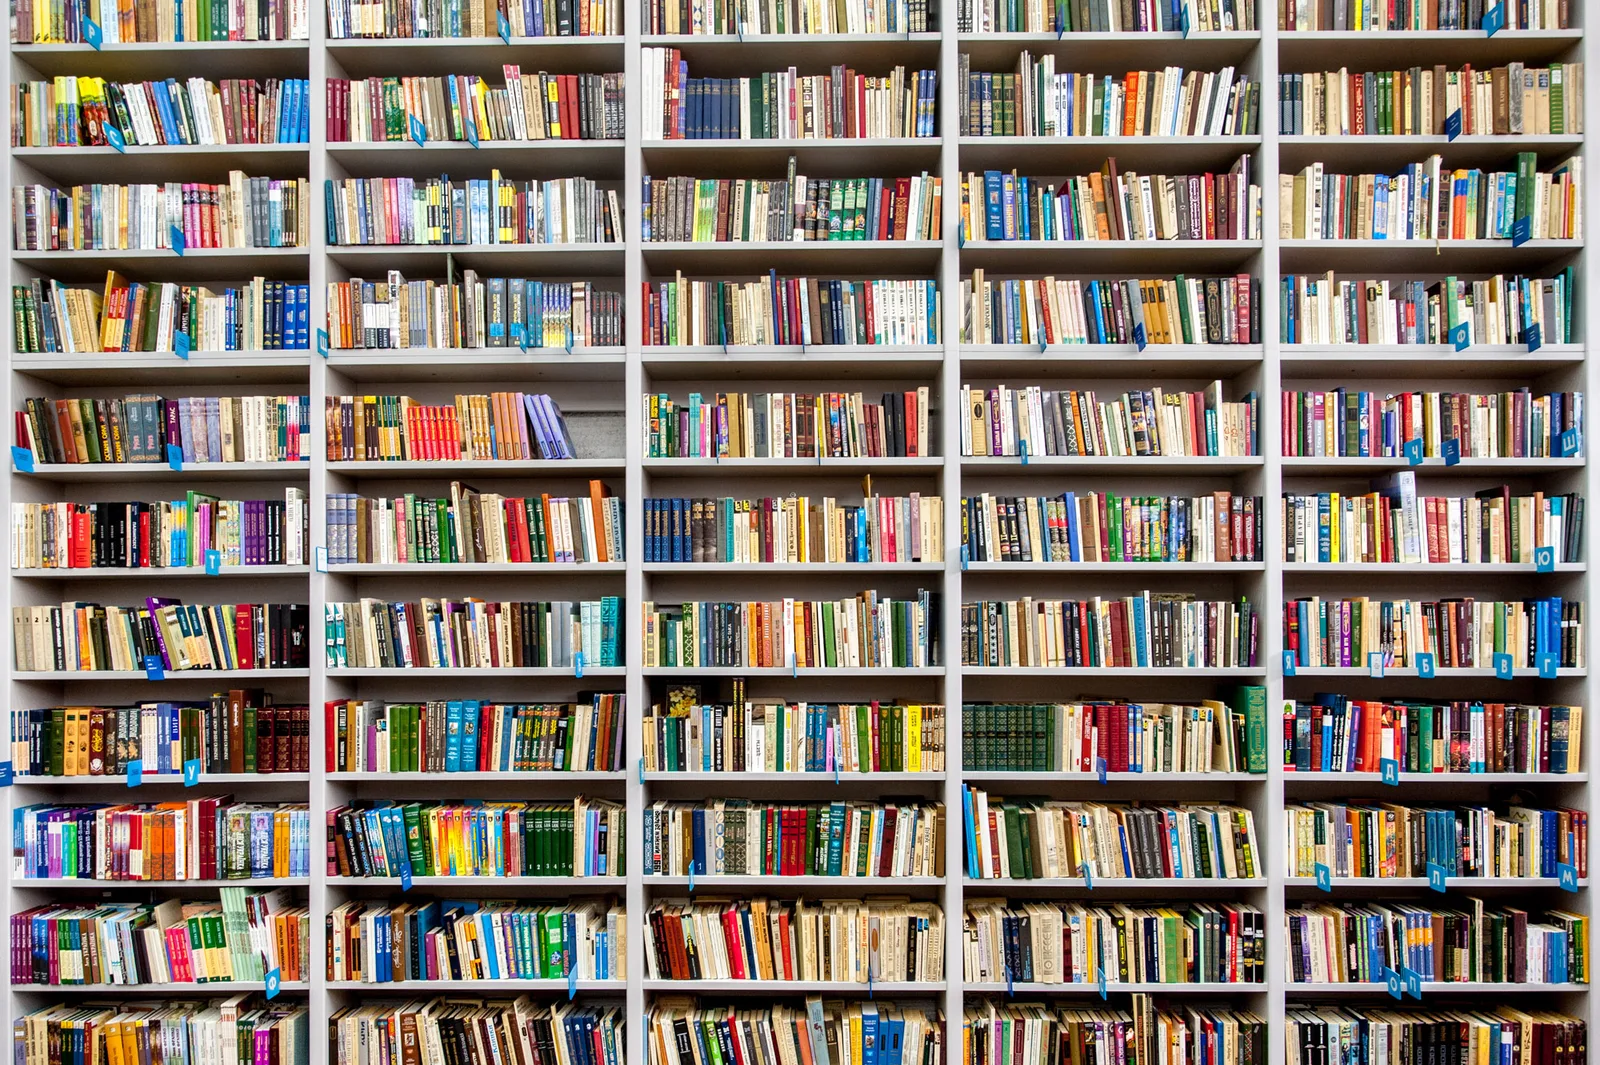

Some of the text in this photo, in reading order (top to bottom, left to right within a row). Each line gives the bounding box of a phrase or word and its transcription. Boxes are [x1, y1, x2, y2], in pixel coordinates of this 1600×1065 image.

[1490, 11, 1497, 26] Т
[88, 24, 96, 38] Р
[108, 132, 120, 146] С
[1563, 434, 1575, 450] Ш
[1412, 446, 1418, 458] Ч
[209, 554, 216, 569] Т
[1538, 552, 1550, 566] Ю
[1286, 655, 1292, 670] Я
[1422, 658, 1430, 672] Б
[1501, 658, 1508, 672] В
[1544, 659, 1550, 672] Г
[1386, 764, 1394, 781] Д
[1319, 870, 1326, 884] К
[1433, 870, 1440, 885] Л
[1562, 870, 1574, 885] М
[1390, 976, 1398, 991] О
[1410, 976, 1416, 992] П
